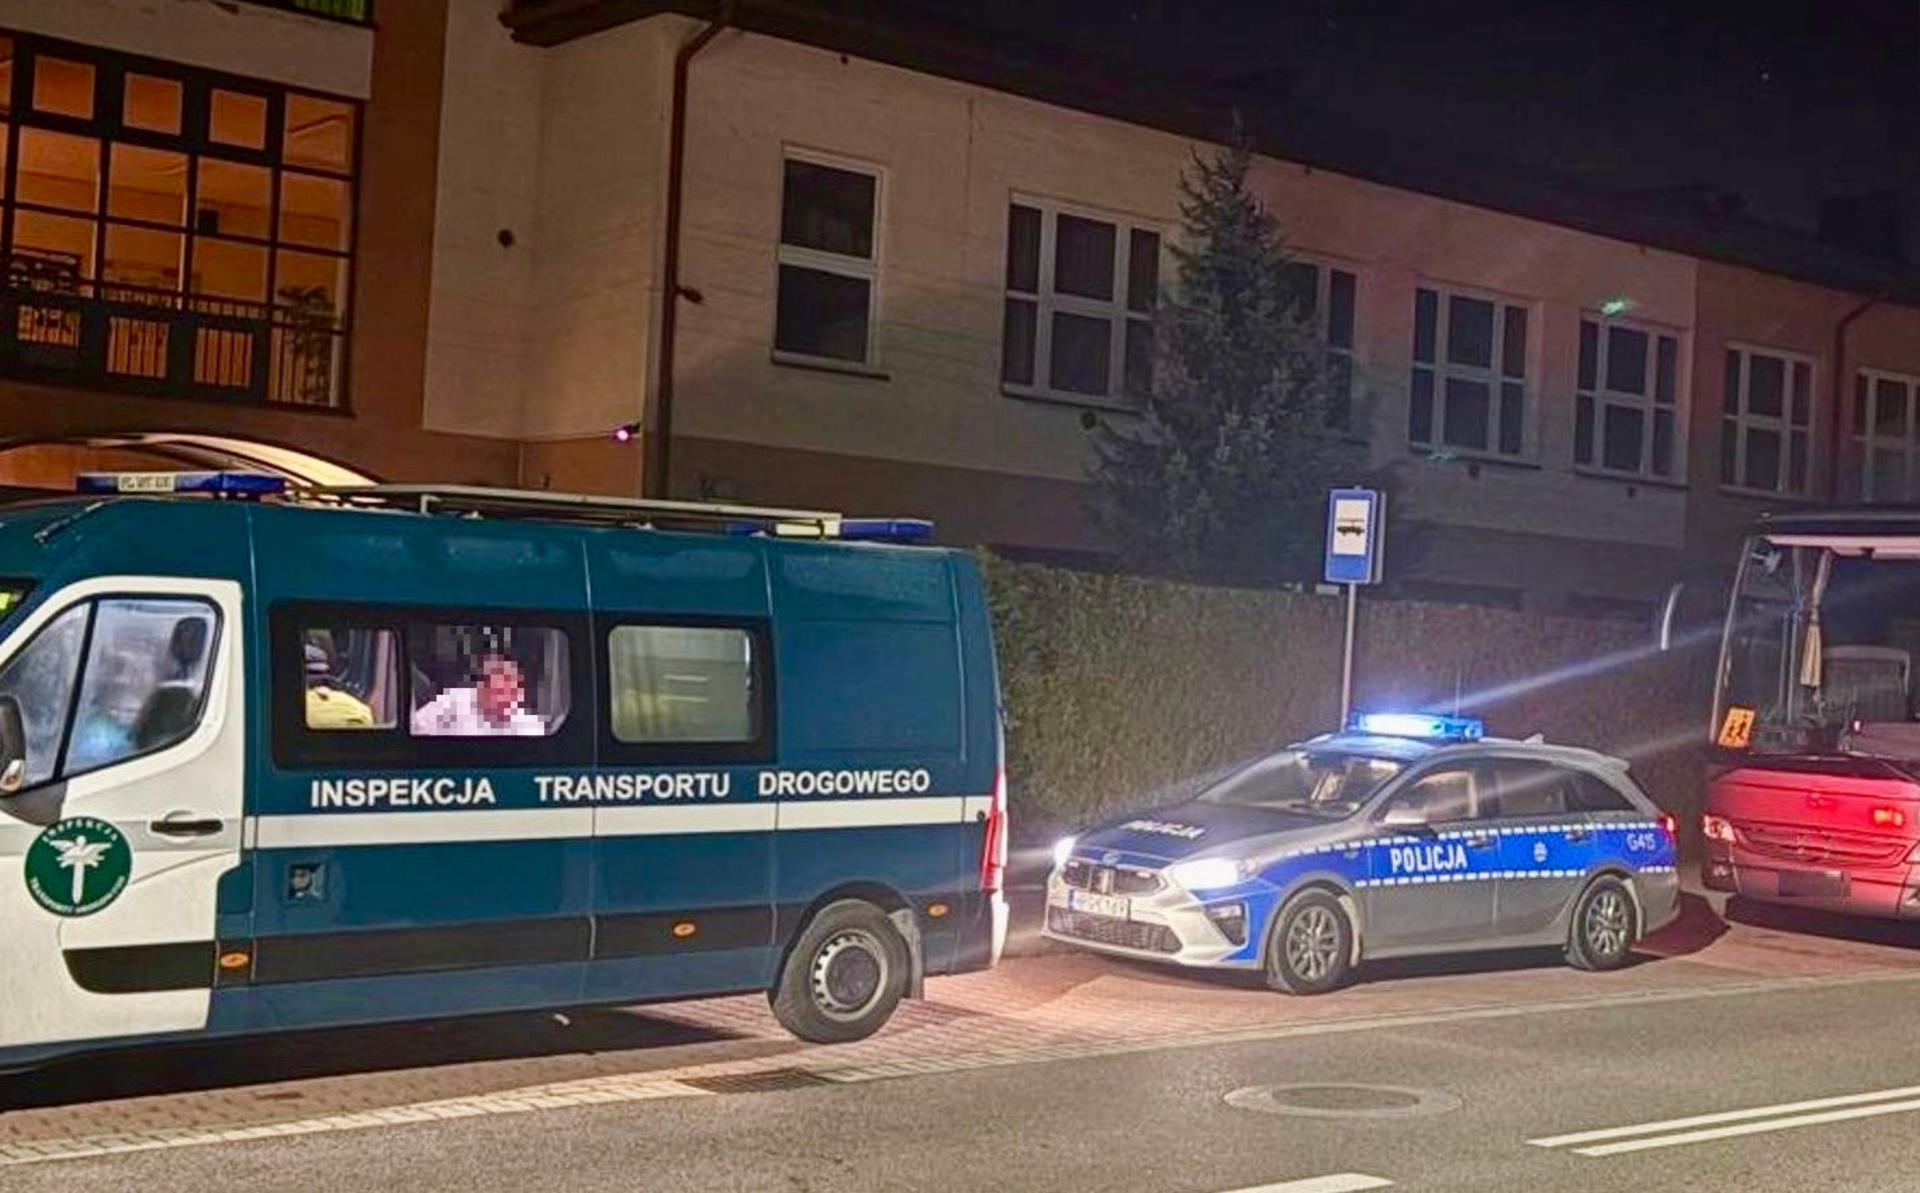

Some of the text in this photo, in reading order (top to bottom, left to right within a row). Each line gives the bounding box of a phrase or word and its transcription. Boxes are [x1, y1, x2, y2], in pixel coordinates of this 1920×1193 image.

[311, 769, 931, 807] INSPEKCJA TRANSPORTU DROGOWEGO
[1390, 844, 1468, 873] POLICJA
